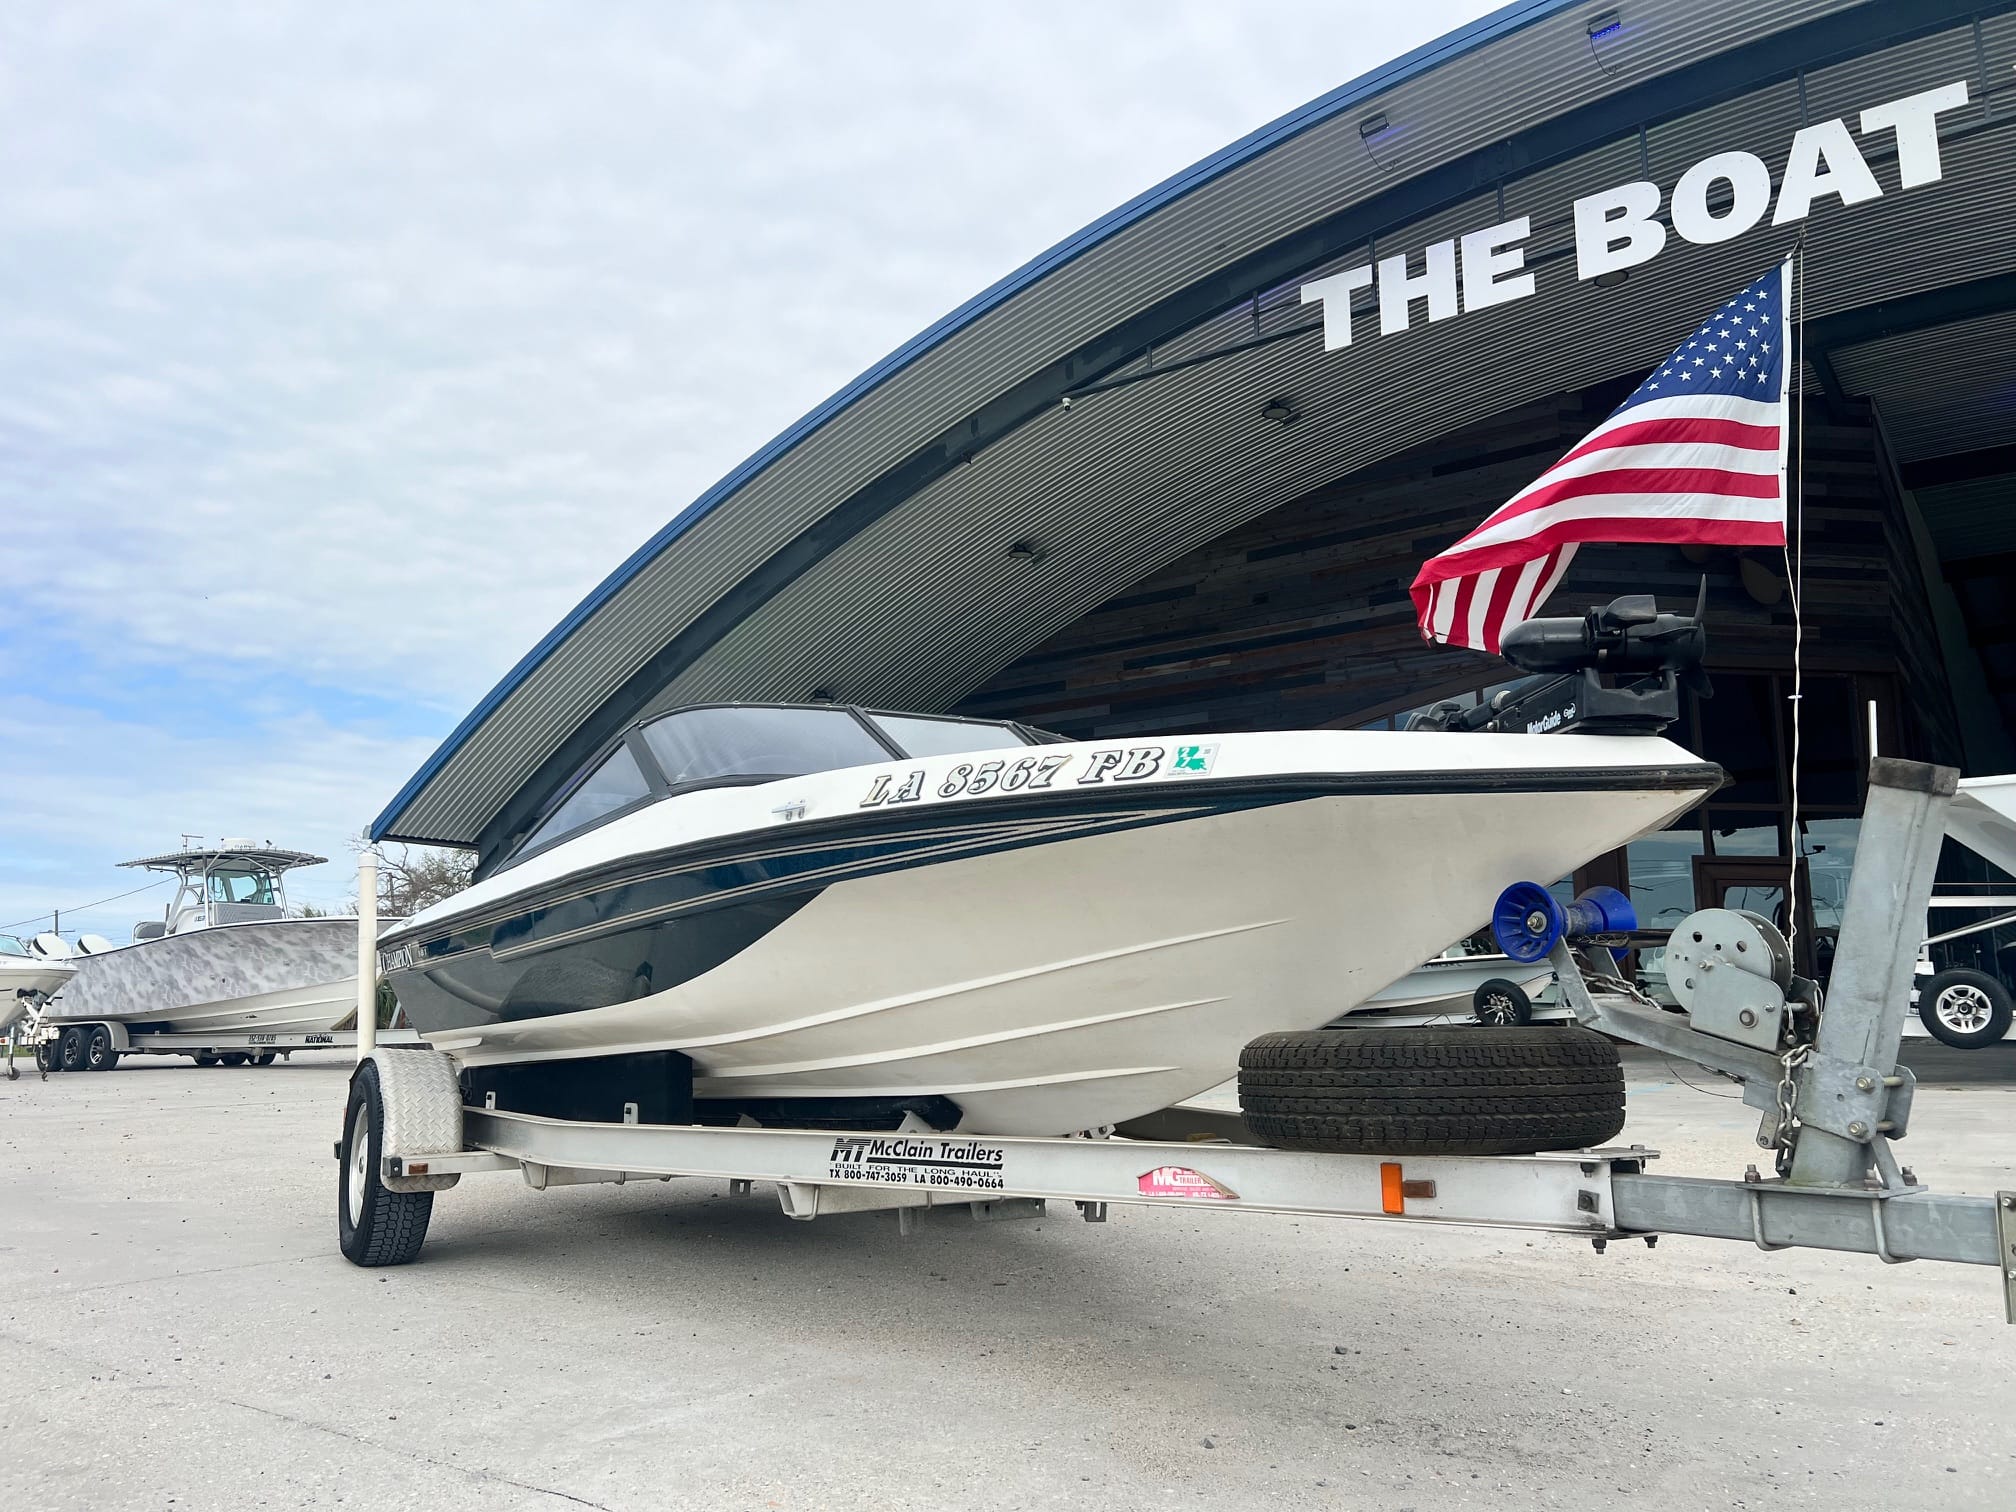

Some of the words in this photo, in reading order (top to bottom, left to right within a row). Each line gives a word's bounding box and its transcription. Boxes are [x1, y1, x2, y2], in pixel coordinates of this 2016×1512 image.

[1301, 216, 1535, 352] THE
[1573, 81, 1968, 281] BOAT
[1527, 710, 1561, 734] MotorGuide
[859, 770, 925, 808] LA
[938, 754, 1073, 799] 8567
[1077, 746, 1165, 785] FB
[383, 944, 413, 974] CHAMPION
[305, 1034, 334, 1044] NATIONAL
[830, 1138, 872, 1162] MT
[869, 1139, 934, 1159] McClain
[940, 1142, 1003, 1161] Trailers
[829, 1169, 840, 1178] TX
[844, 1170, 907, 1182] 800-747-3059
[914, 1174, 926, 1184] LA
[930, 1175, 1004, 1189] 800-490-0664
